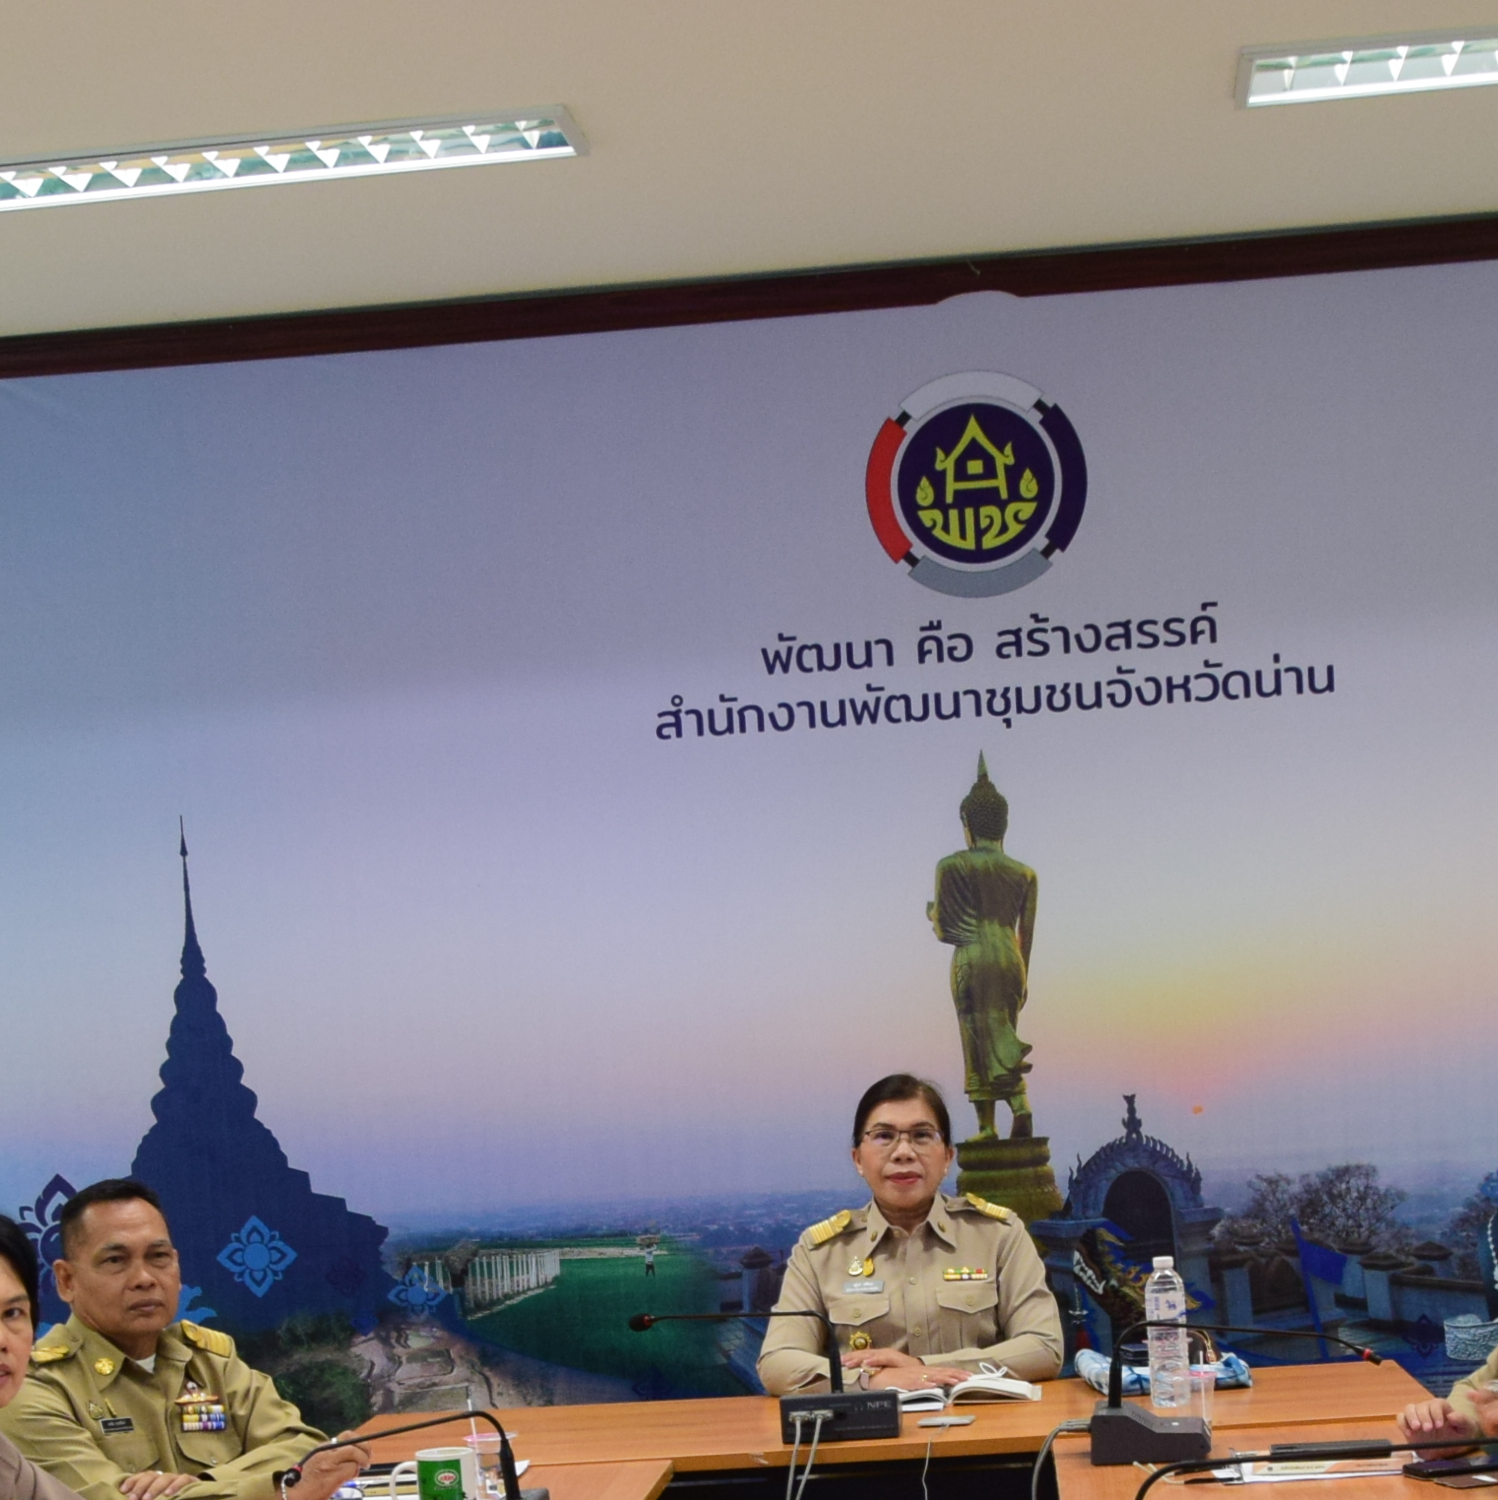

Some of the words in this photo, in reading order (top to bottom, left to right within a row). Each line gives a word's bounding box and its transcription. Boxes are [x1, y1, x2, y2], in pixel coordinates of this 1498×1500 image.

[760, 632, 894, 676] พัฒนา
[916, 619, 975, 665] คือ
[995, 601, 1218, 660] สร้างสรรค์
[655, 653, 1336, 741] สำนักงานพัฒนาชุมชนจังหวัดน่าน
